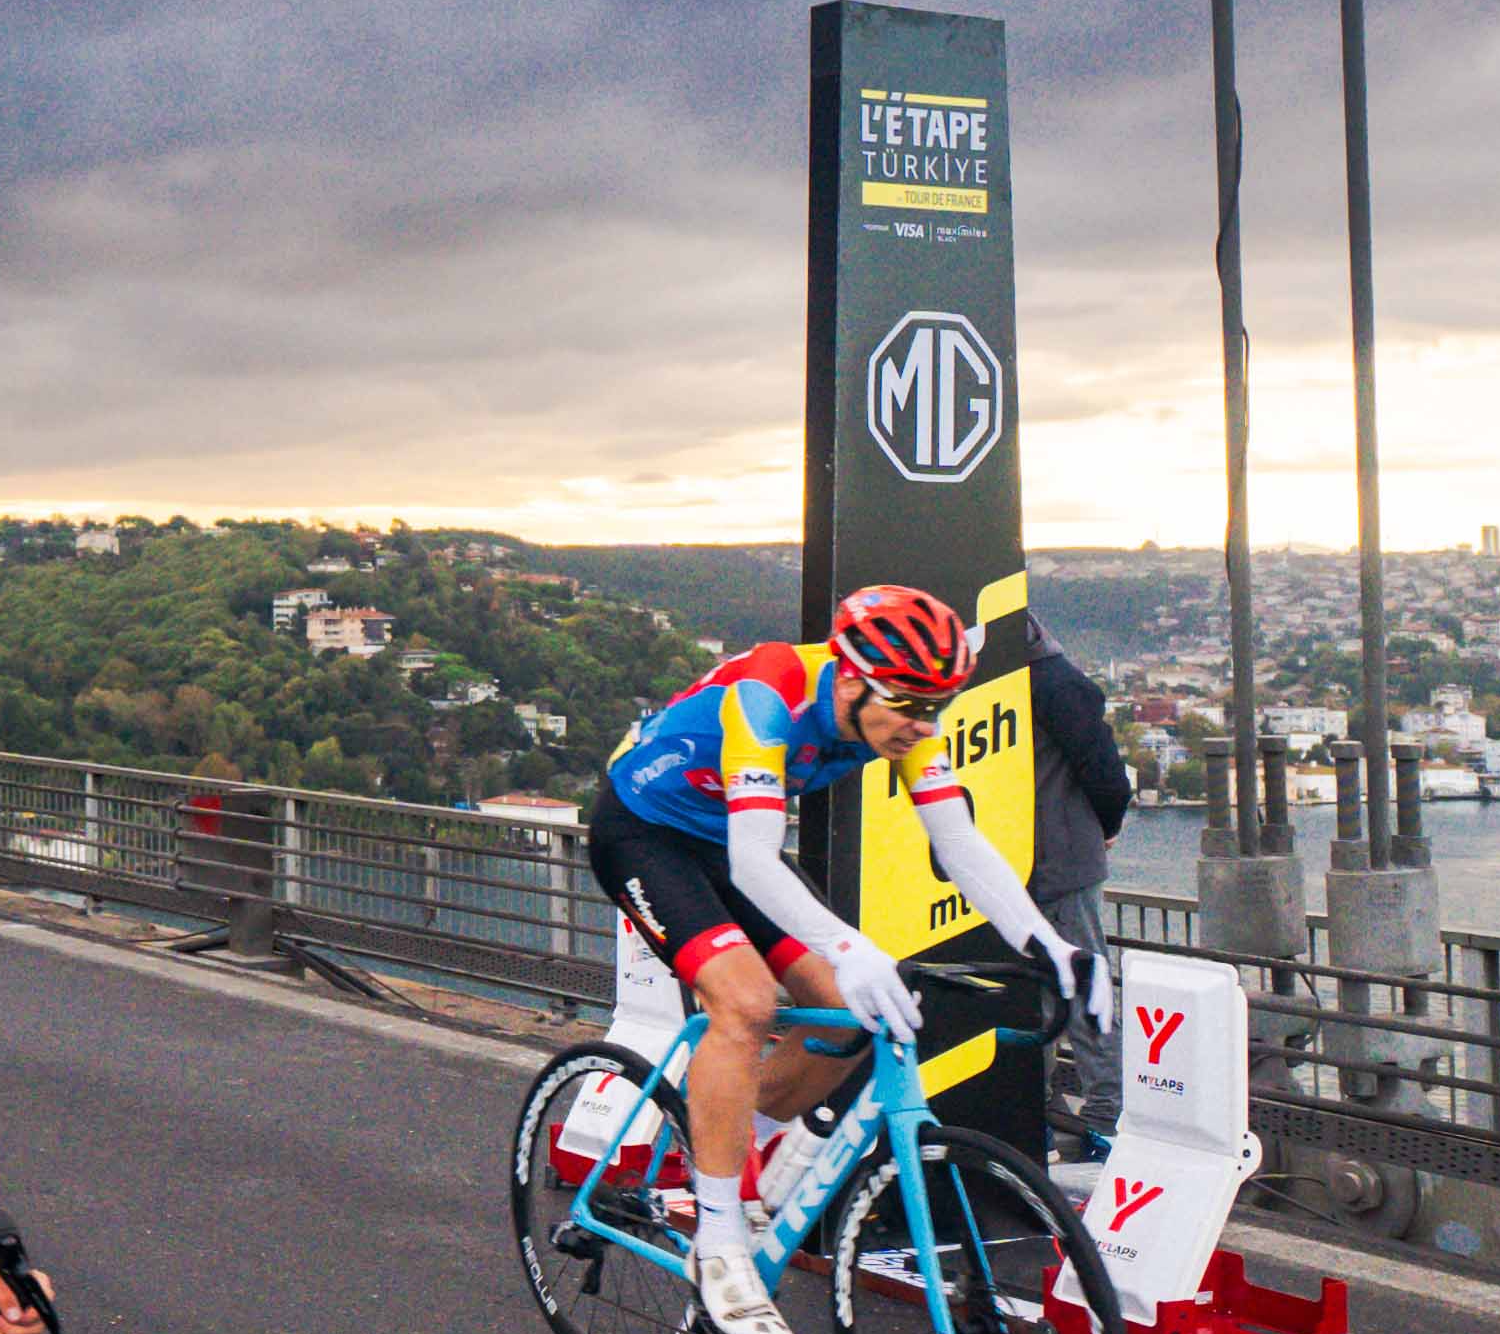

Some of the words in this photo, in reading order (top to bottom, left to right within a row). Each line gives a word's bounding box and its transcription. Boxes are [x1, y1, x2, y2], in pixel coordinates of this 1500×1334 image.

[861, 91, 987, 151] L'ÉTAPE
[862, 148, 988, 184] TÜRKİYE
[904, 190, 930, 205] TOUR
[932, 192, 945, 206] DE
[946, 193, 984, 209] FRANCE
[893, 221, 925, 238] VISA
[880, 327, 990, 466] MG
[1136, 1073, 1185, 1092] MYLAPS
[751, 1078, 884, 1264] TREK
